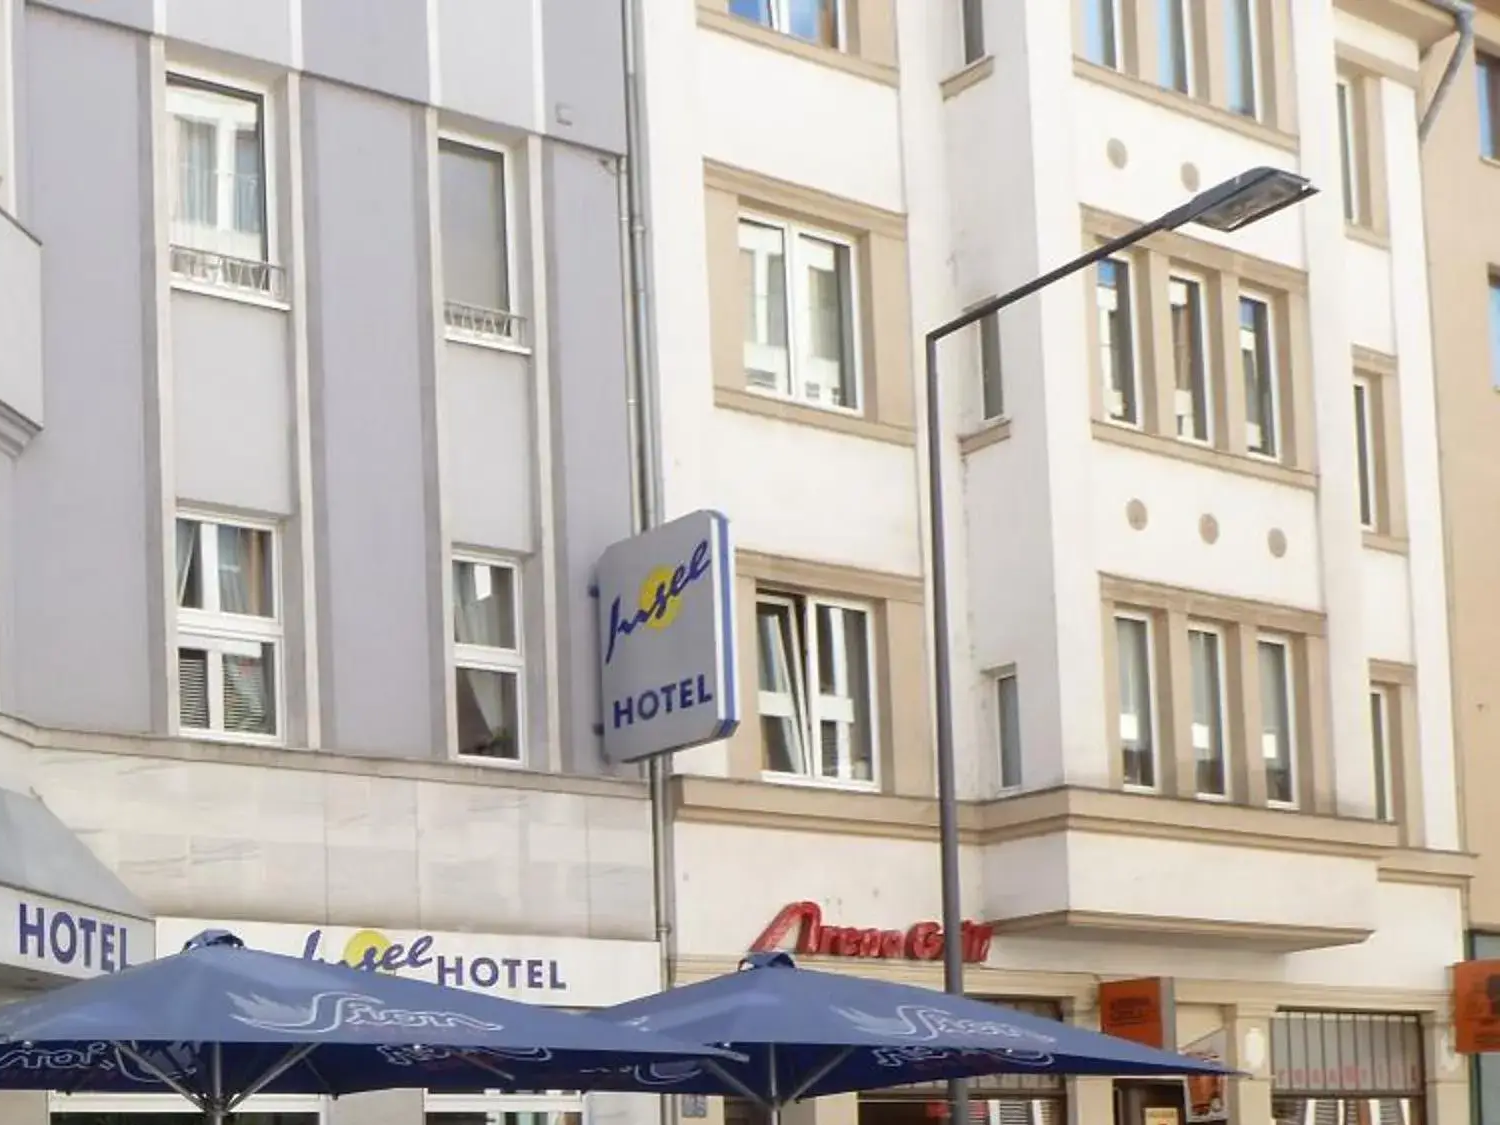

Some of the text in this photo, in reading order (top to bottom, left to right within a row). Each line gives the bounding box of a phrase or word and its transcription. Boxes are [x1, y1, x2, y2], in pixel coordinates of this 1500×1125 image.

[613, 675, 713, 728] HOTEL
[19, 902, 129, 974] HOTEL
[438, 955, 567, 989] HOTEL
